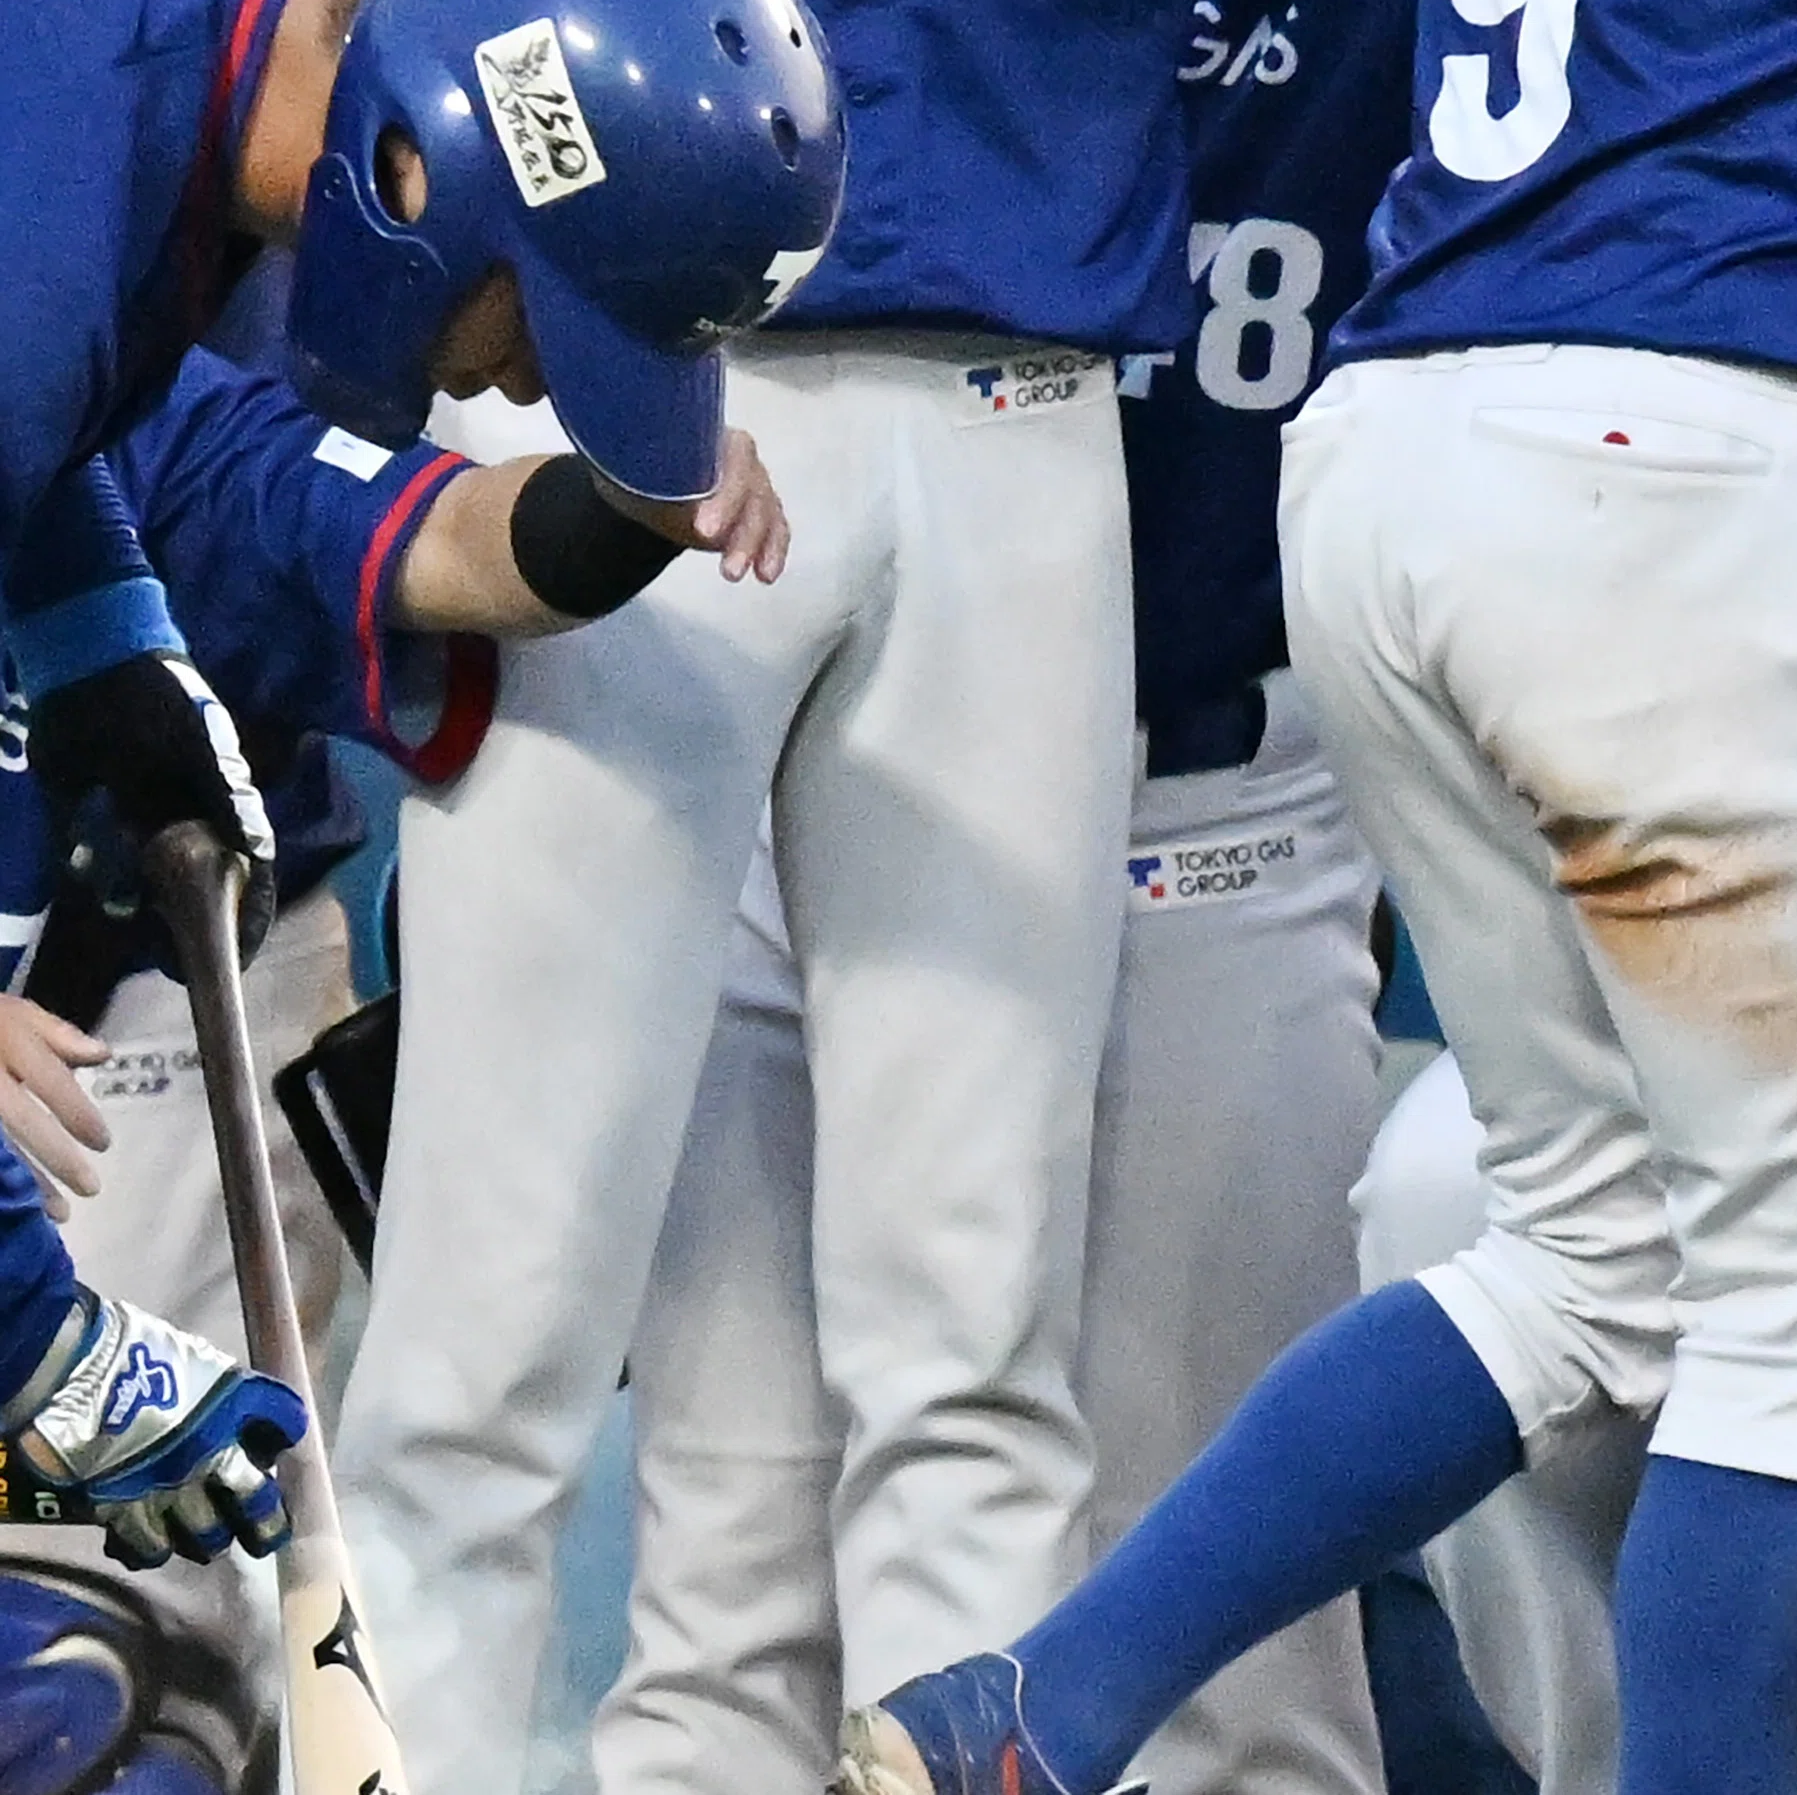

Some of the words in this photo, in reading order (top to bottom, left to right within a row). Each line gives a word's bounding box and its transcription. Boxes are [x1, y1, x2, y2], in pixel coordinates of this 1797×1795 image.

[1014, 378, 1079, 408] GROUP
[1174, 844, 1251, 872] TOKYO
[1177, 868, 1258, 897] GROUP
